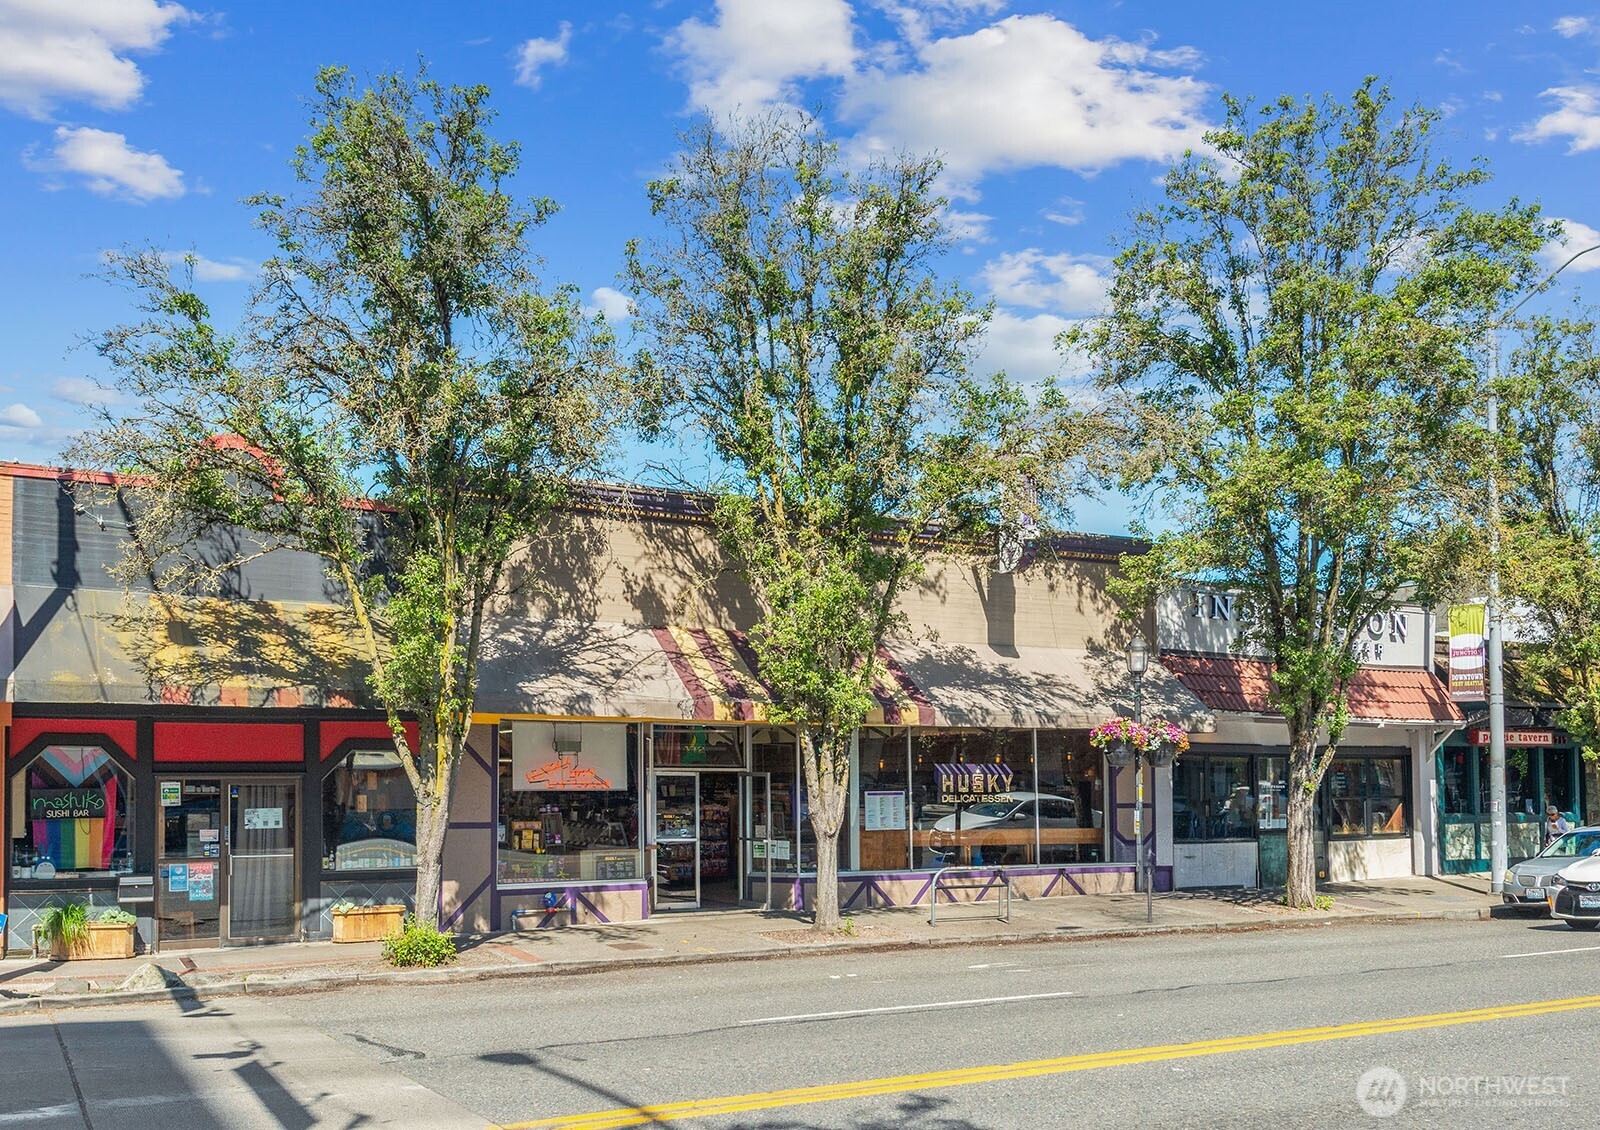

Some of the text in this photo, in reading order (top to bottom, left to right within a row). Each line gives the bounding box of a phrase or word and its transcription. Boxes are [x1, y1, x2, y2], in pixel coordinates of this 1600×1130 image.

[1452, 649, 1483, 657] JUNCTION
[1451, 673, 1484, 681] DOWNTOWN
[1483, 732, 1549, 742] pie tavern
[942, 773, 1014, 793] HUSKY
[941, 794, 1014, 803] DELICATESSEN
[46, 809, 89, 818] SUSHI BAR
